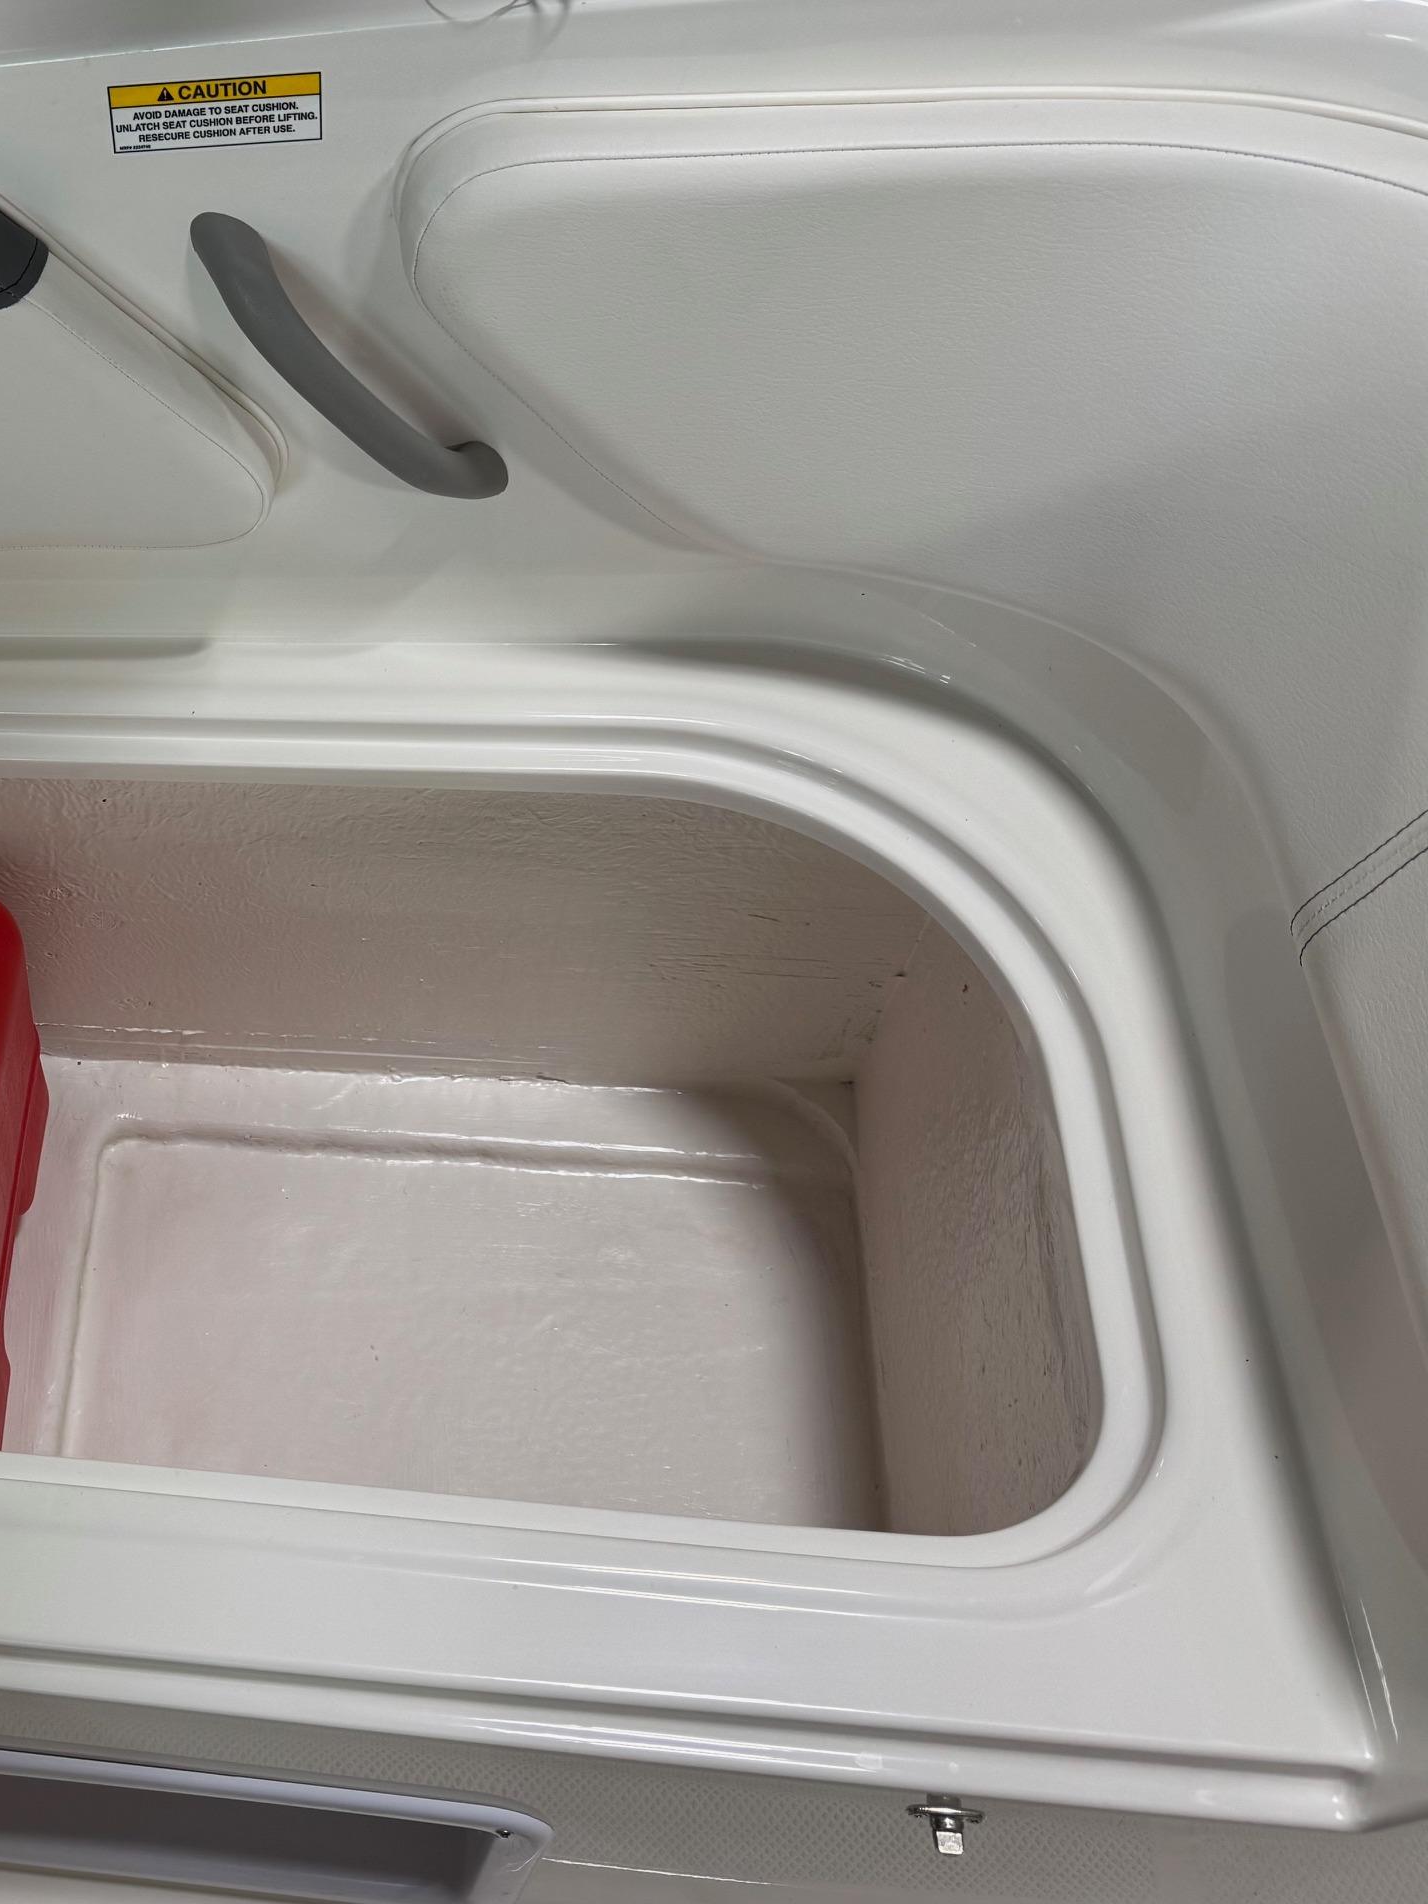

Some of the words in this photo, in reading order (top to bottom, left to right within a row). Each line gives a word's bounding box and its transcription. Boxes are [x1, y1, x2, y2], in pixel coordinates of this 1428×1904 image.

[178, 80, 267, 101] CAUTION
[132, 110, 162, 121] AVOID
[164, 107, 207, 119] DAMAGE
[209, 106, 222, 116] TO
[224, 104, 249, 115] SEAT
[252, 101, 299, 113] CUSHION.
[115, 121, 160, 133] UNLATCH
[162, 119, 187, 130] SEAT
[189, 117, 233, 128] CUSHION
[235, 114, 275, 125] BEFORE
[277, 111, 318, 123] LIFTING.
[138, 132, 191, 143] RESECURE
[192, 129, 237, 140] CUSHION
[239, 126, 271, 137] AFTER
[273, 124, 296, 135] USE.
